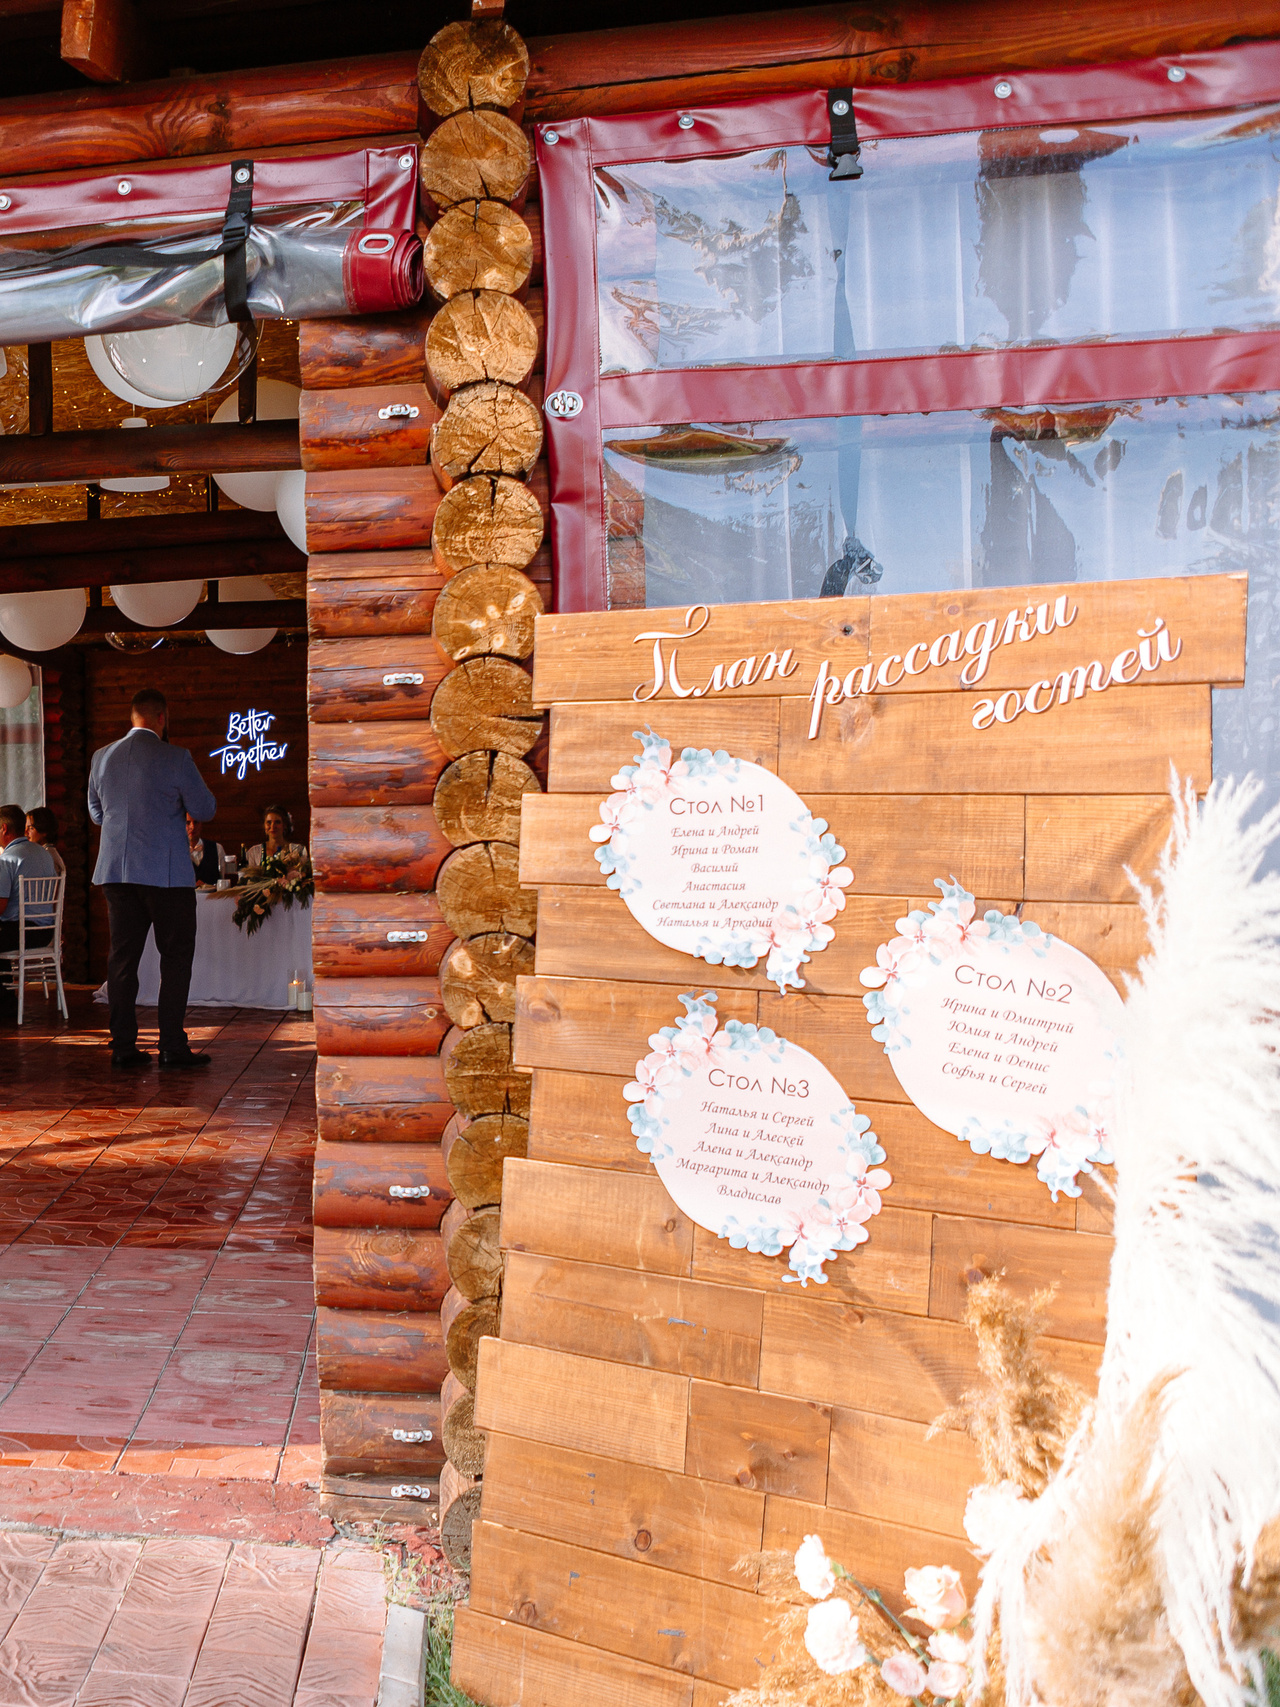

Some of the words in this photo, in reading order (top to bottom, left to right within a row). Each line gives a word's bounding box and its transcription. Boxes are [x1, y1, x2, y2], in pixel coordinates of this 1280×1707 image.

[633, 605, 799, 703] План
[808, 594, 1078, 740] рассадки
[971, 618, 1183, 731] гостей
[226, 708, 276, 743] Better
[209, 732, 288, 780] Together
[669, 797, 722, 815] Стол
[730, 794, 763, 813] №1
[670, 827, 705, 838] Елена
[716, 824, 760, 839] Андрей
[670, 844, 708, 859] Ирина
[721, 844, 759, 855] Роман
[690, 862, 739, 873] Василий
[682, 881, 746, 893] Анастасия
[652, 899, 706, 910] Светлана
[716, 897, 779, 912] Александр
[656, 916, 709, 927] Наталья
[721, 916, 773, 931] Аркадий
[954, 964, 1016, 994] Стол
[1026, 977, 1073, 1004] №2
[940, 997, 987, 1016] Ирина
[1002, 1010, 1075, 1034] Дмитрий
[947, 1020, 991, 1039] Юлия
[1003, 1032, 1059, 1053] Андрей
[948, 1041, 990, 1060] Елена
[1005, 1054, 1050, 1073] Денис
[708, 1068, 763, 1093] Стол
[771, 1076, 810, 1099] №3
[941, 1061, 985, 1080] Софья
[1001, 1075, 1048, 1095] Сергей
[699, 1101, 758, 1119] Наталья
[772, 1111, 815, 1128] Сергей
[704, 1122, 739, 1137] Лина
[751, 1129, 805, 1148] Алескей
[692, 1140, 732, 1157] Алена
[744, 1148, 814, 1172] Александр
[675, 1157, 748, 1179] Маргарита
[760, 1172, 830, 1195] Александр
[716, 1184, 782, 1205] Владислав
